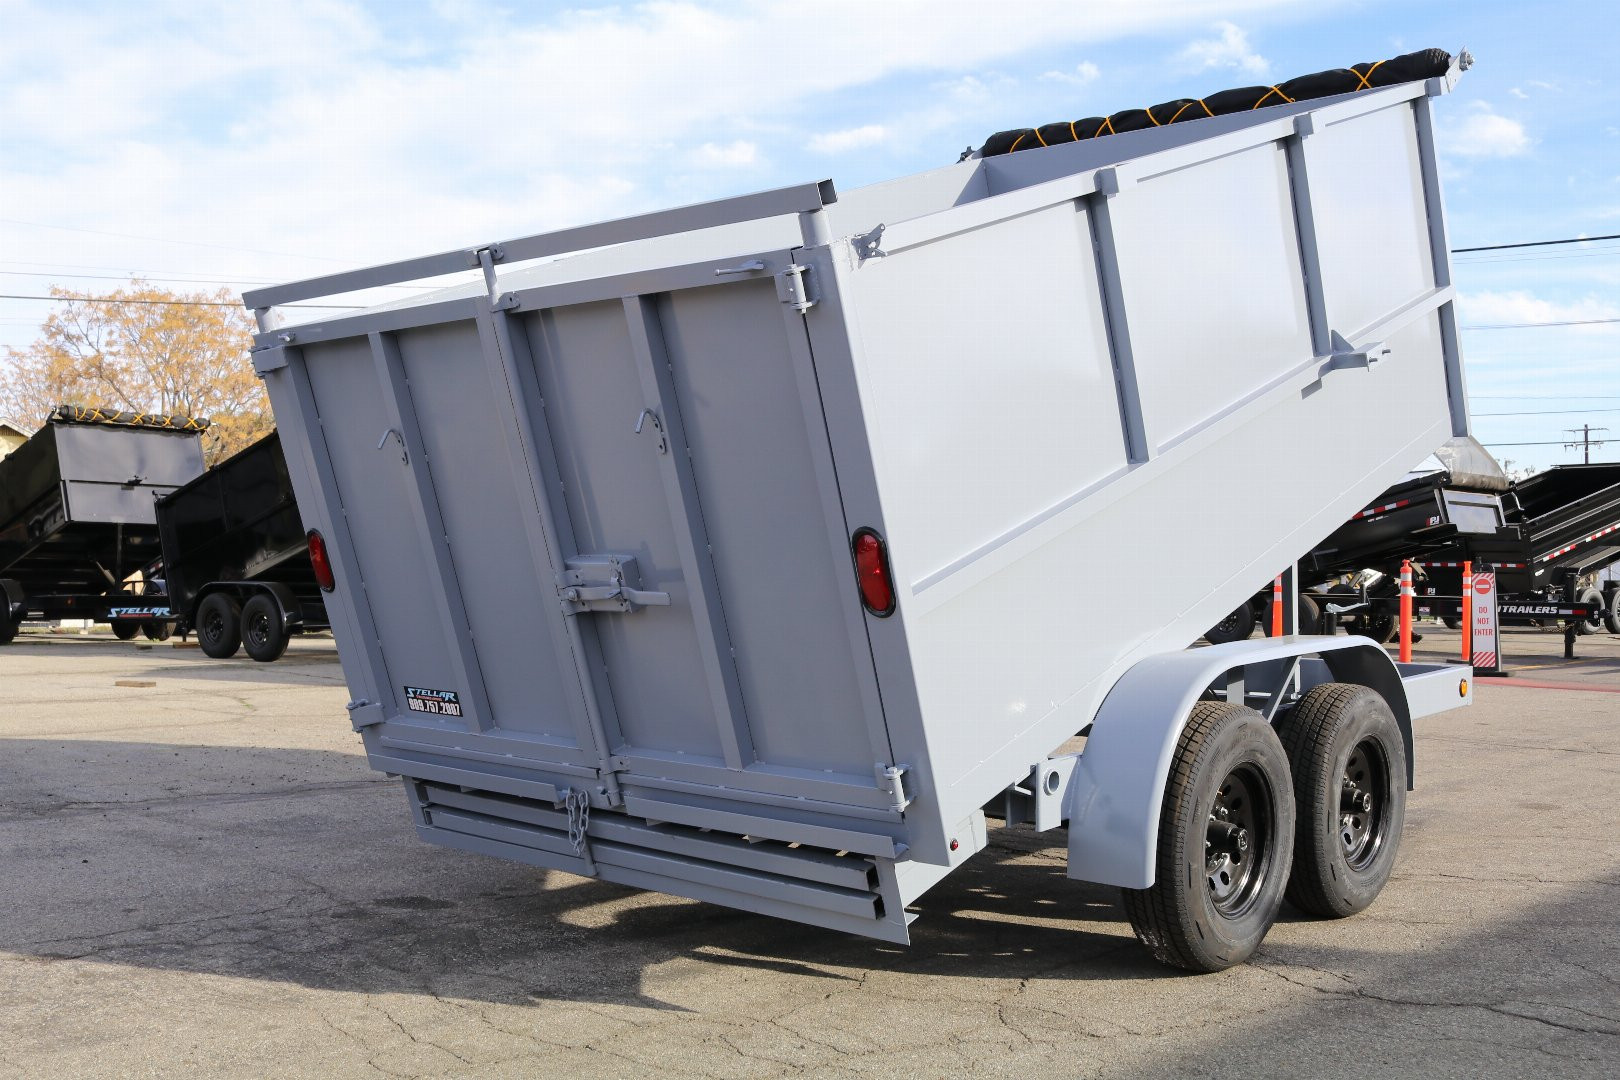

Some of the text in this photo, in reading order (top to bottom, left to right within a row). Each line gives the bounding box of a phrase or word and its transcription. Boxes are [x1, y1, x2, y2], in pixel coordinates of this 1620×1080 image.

[107, 607, 170, 618] STELLAR
[1478, 606, 1488, 614] DO
[1502, 605, 1558, 614] TRAILERS
[1477, 617, 1489, 625] NOT
[1474, 628, 1493, 636] ENTER
[407, 687, 456, 701] STELLAR
